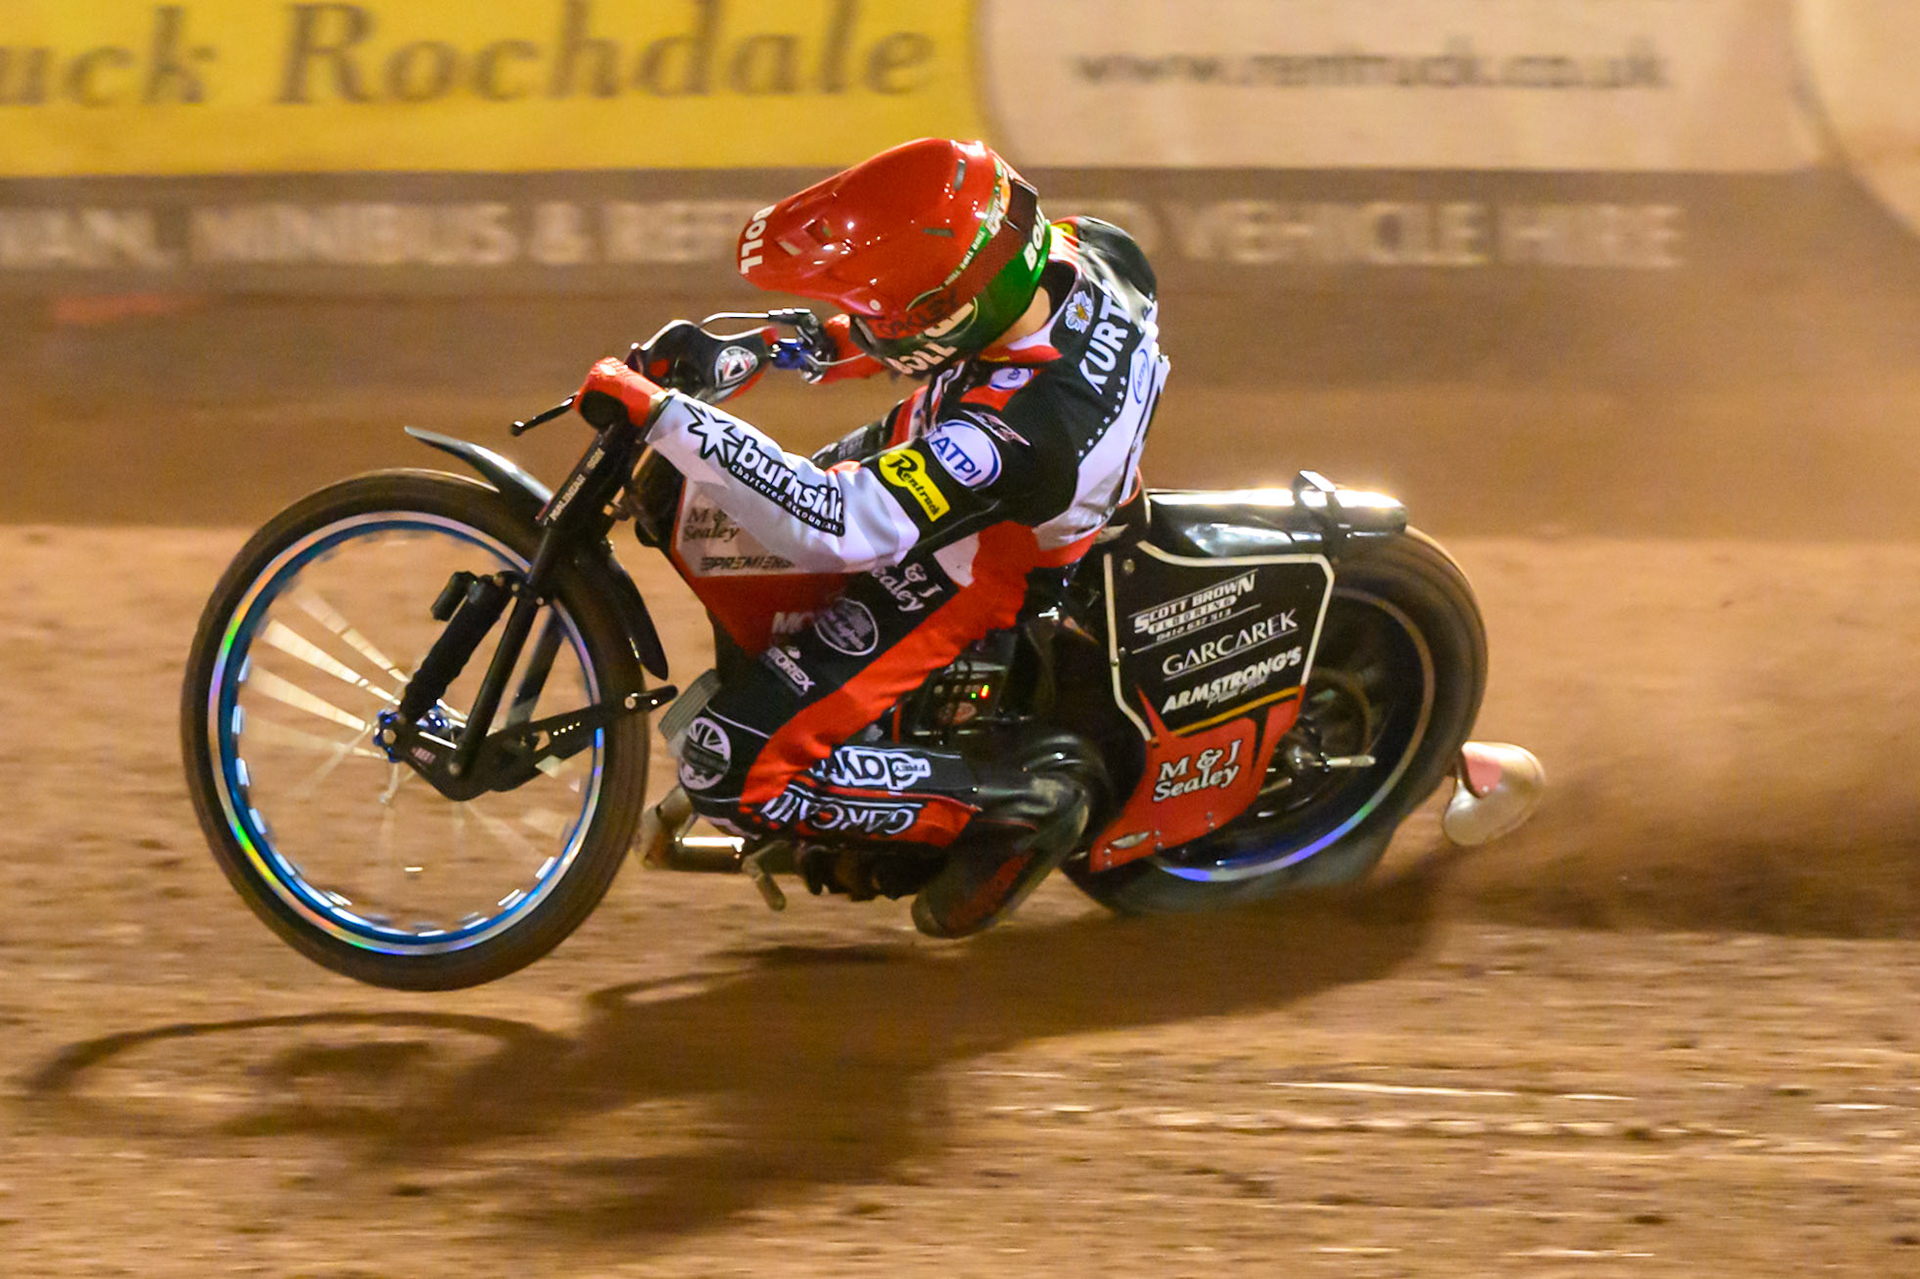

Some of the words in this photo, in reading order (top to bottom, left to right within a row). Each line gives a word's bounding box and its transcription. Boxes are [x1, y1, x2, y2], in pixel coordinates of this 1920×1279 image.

[278, 2, 938, 104] Rochdale
[740, 204, 777, 275] BOLL
[887, 453, 940, 516] Rentruck
[931, 436, 982, 482] ATPI
[871, 564, 925, 612] ealey
[1134, 600, 1188, 634] SCOTT
[1192, 573, 1256, 608] BROWN
[766, 646, 816, 692] OREX
[1162, 607, 1298, 677] GARCAREK
[1161, 646, 1303, 715] ARMSTRONG'S
[1153, 765, 1241, 803] Sealey
[1158, 757, 1190, 781] M
[1196, 749, 1224, 770] &
[1224, 739, 1242, 765] J
